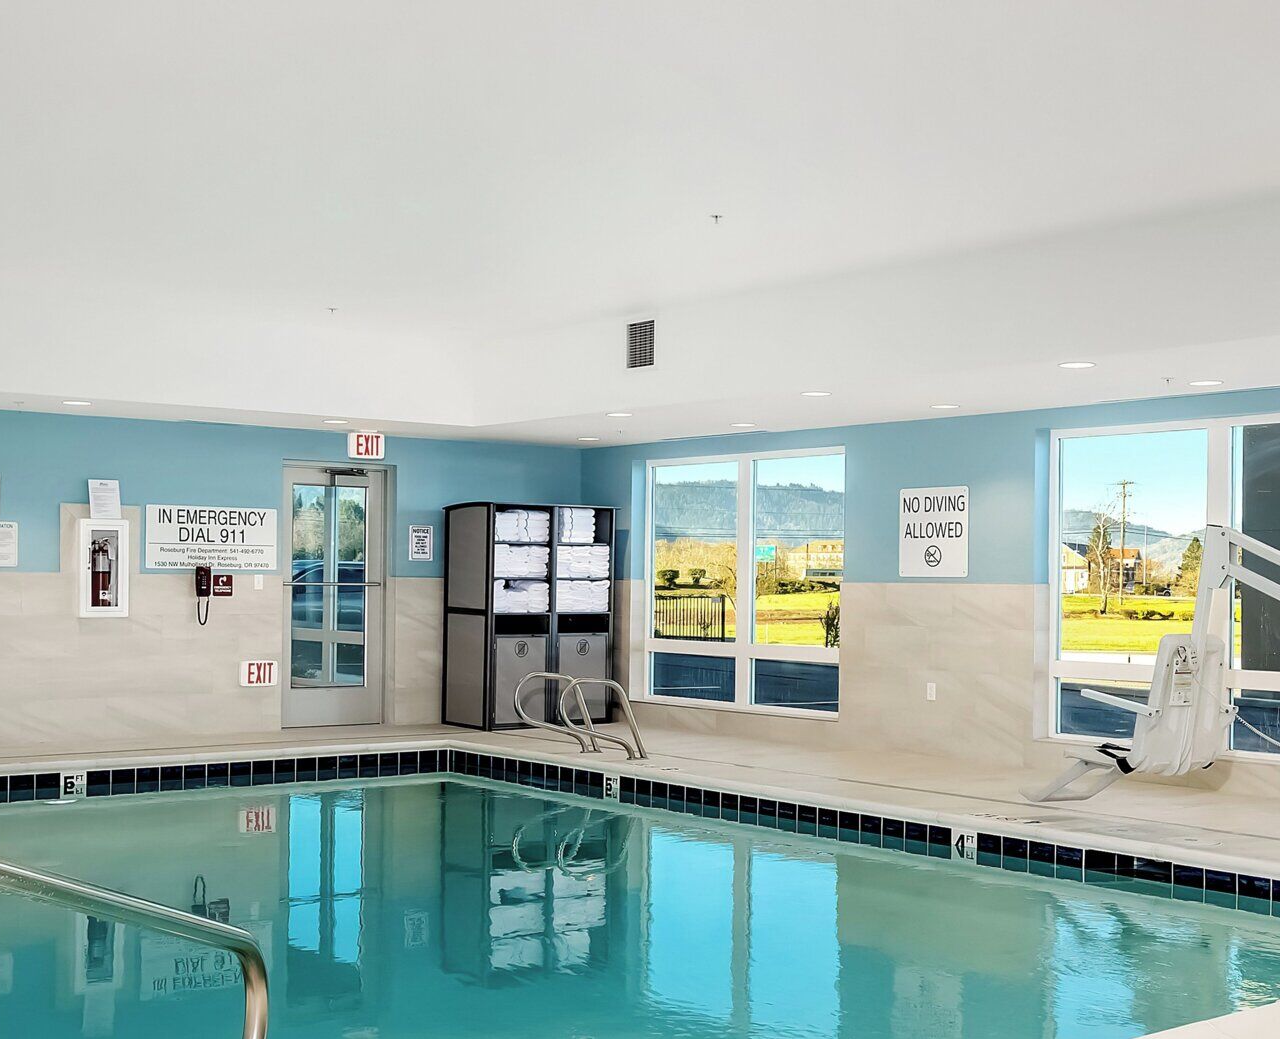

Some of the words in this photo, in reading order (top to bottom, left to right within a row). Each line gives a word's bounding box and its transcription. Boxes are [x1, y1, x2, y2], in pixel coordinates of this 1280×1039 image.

[356, 434, 380, 456] EXIT
[903, 497, 920, 513] NO
[924, 495, 965, 512] DIVING
[158, 509, 172, 523] IN
[177, 509, 266, 526] EMERGENCY
[179, 527, 215, 542] DIAL
[220, 529, 245, 543] 911
[904, 522, 963, 538] ALLOWED
[248, 662, 274, 684] EXIT
[966, 835, 974, 843] FT
